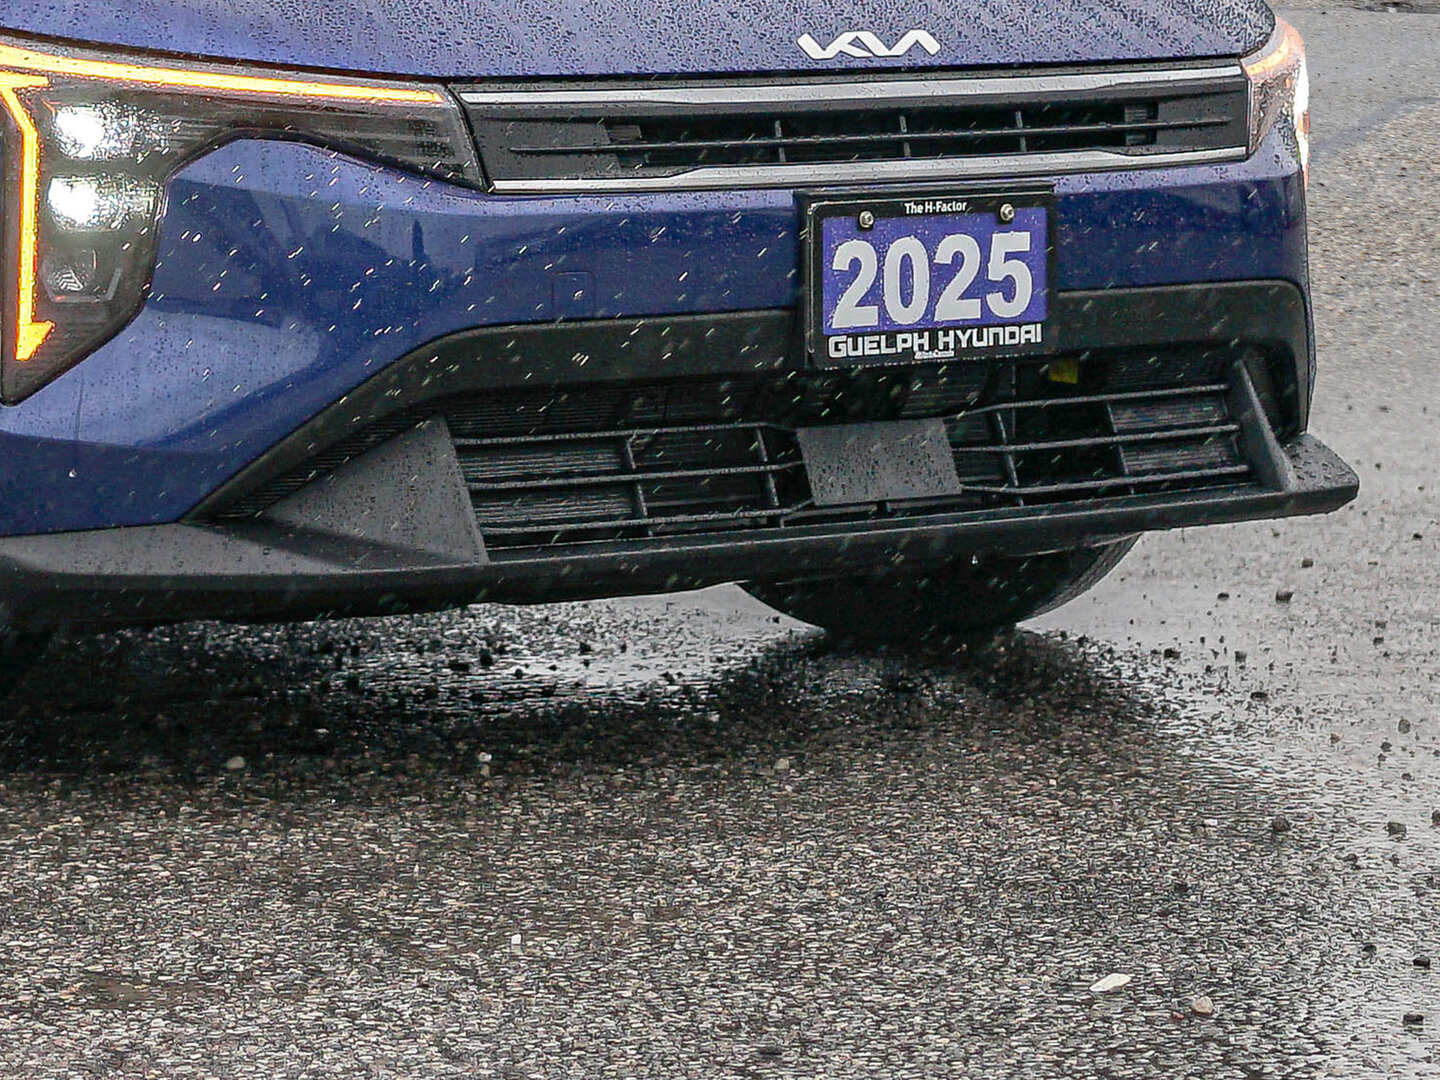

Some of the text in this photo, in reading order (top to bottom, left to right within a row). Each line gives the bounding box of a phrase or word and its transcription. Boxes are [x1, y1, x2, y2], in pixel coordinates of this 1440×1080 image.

[904, 200, 967, 214] The H-Factor
[831, 230, 1033, 329] 2025
[828, 331, 930, 359] GUELPH
[938, 323, 1042, 352] HYUNDAI
